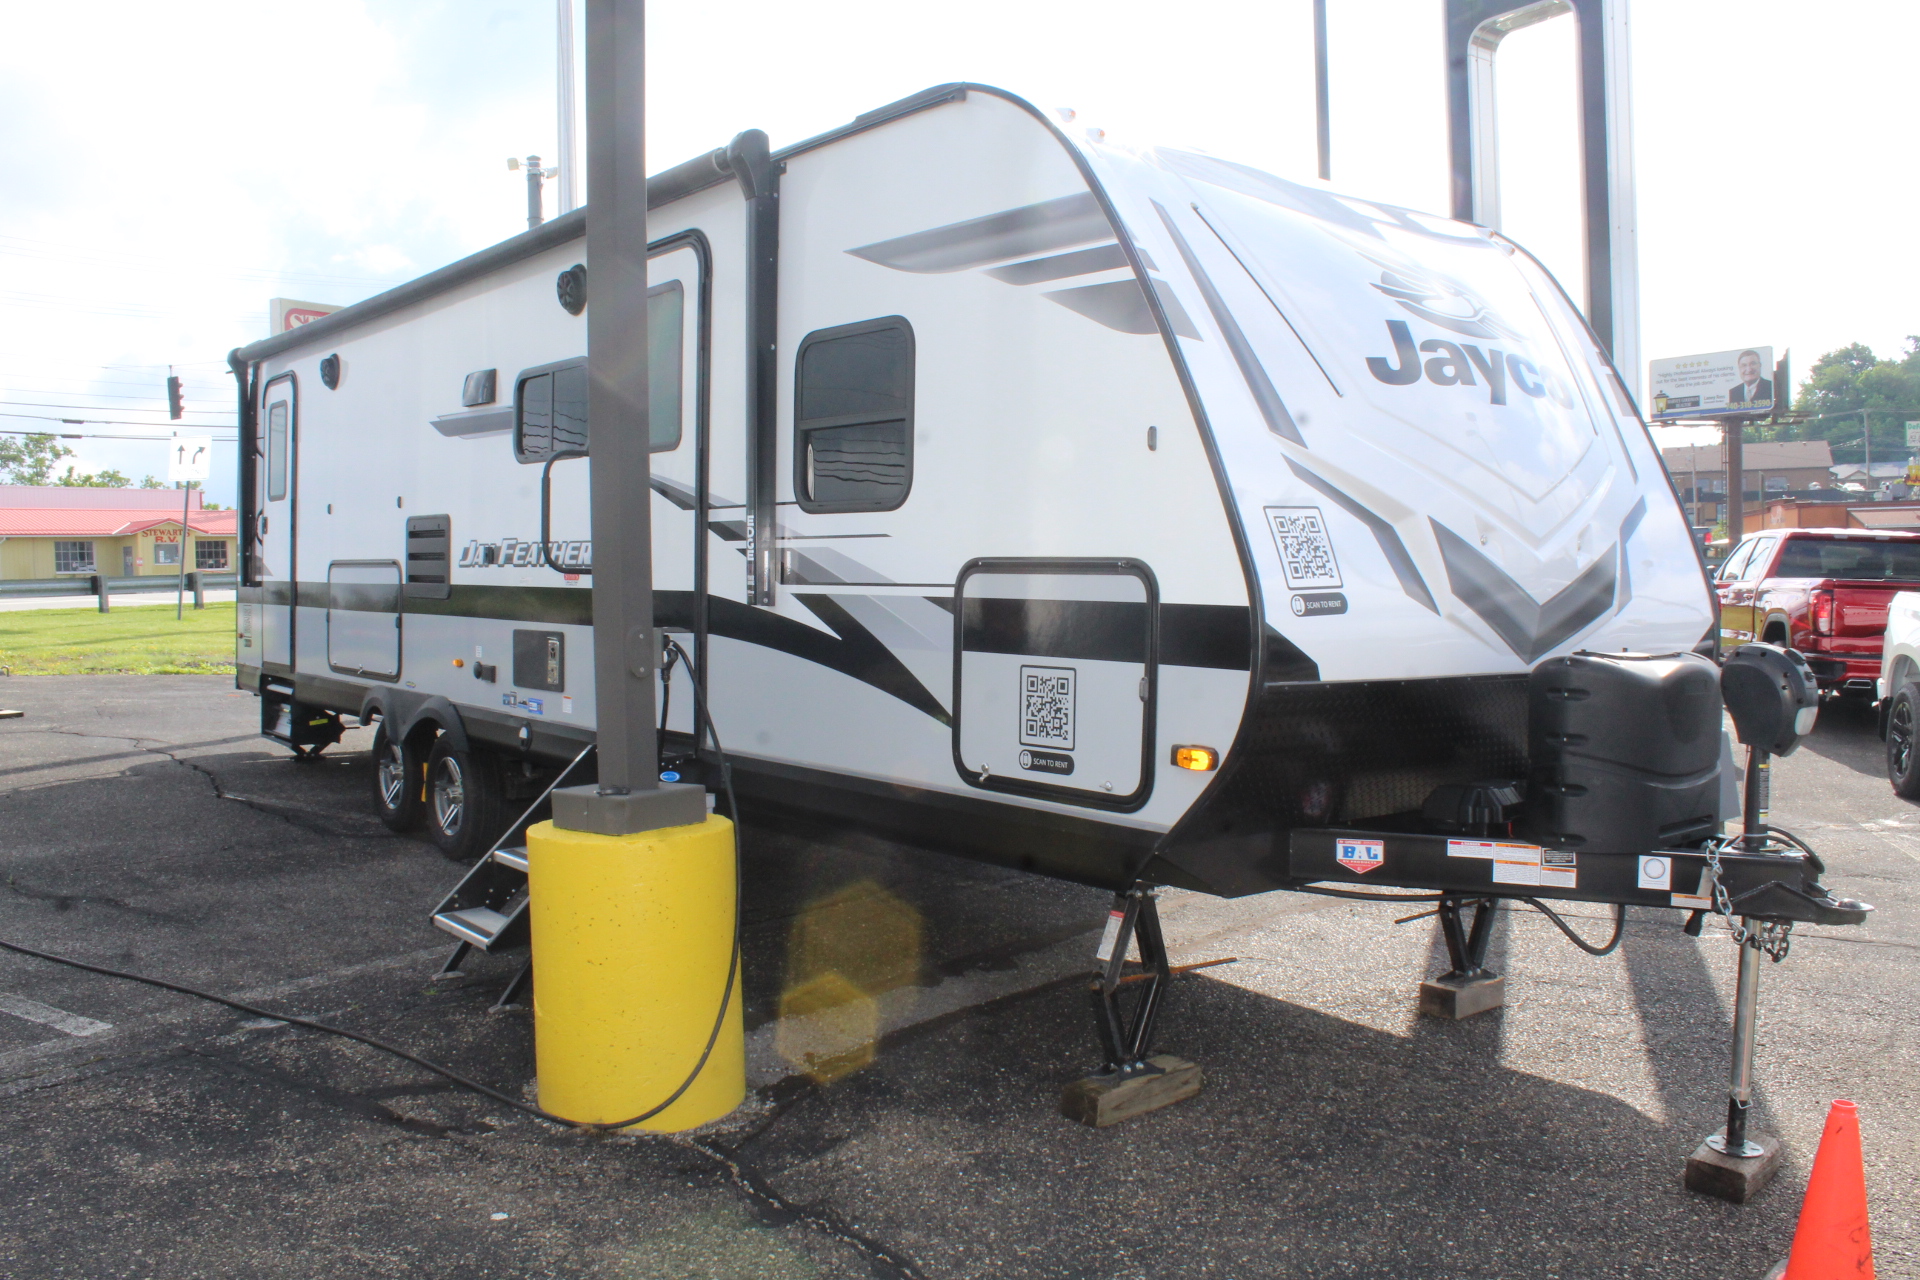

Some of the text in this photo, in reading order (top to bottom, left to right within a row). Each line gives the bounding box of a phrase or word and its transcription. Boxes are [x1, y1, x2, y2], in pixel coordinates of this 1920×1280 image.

[1365, 319, 1575, 410] Jayco
[142, 529, 190, 538] STEWARTS
[747, 514, 755, 561] EDGE
[459, 539, 498, 568] JA
[1306, 601, 1320, 609] SCAN
[1033, 757, 1068, 769] SCAN TO RENT
